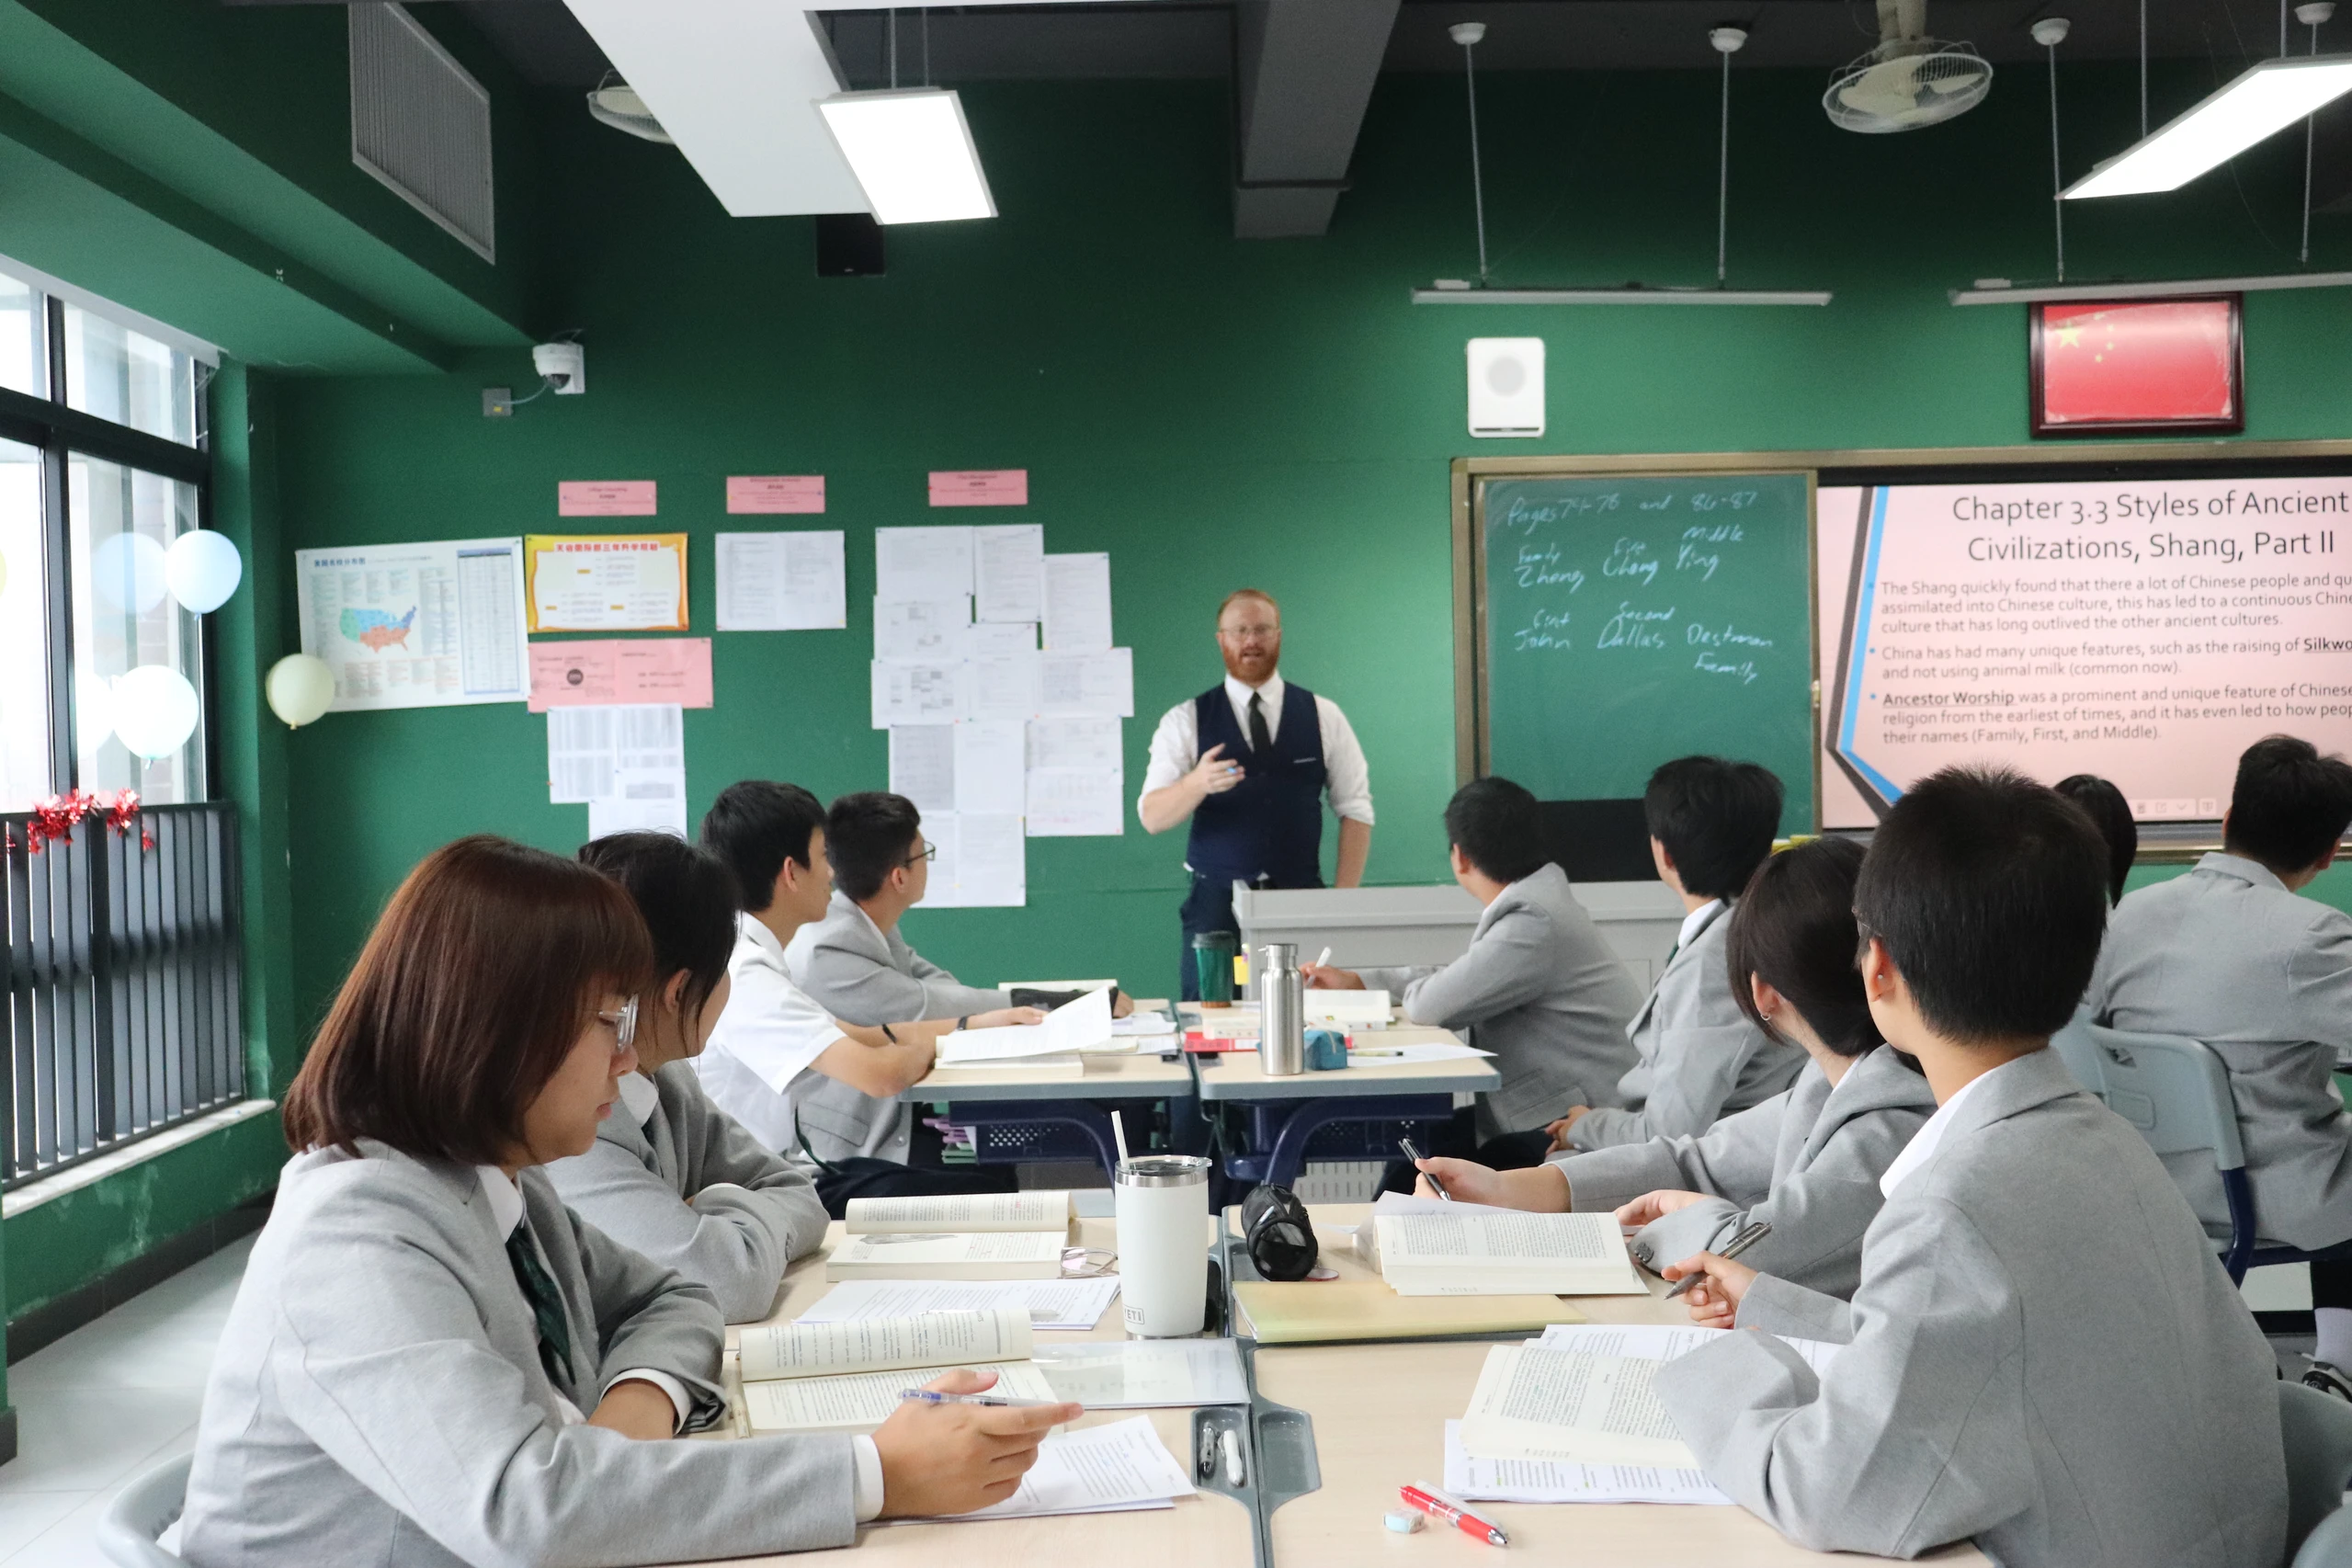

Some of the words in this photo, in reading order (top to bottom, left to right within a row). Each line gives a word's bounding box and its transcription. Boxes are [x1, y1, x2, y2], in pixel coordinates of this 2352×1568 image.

[1953, 495, 2063, 527] Chapter
[2071, 500, 2108, 525] 3.3
[2116, 492, 2199, 524] Styles
[2208, 490, 2236, 516] of
[2242, 490, 2349, 515] Ancient
[1968, 535, 2140, 564] Civilizations,
[2150, 532, 2244, 564] Shang,
[2255, 531, 2312, 555] Part
[2321, 529, 2334, 553] II
[1880, 581, 1908, 595] The
[1911, 581, 1957, 597] Shang
[1960, 579, 2011, 596] quickly
[2015, 578, 2057, 593] found
[2061, 579, 2091, 592] that
[2095, 578, 2132, 591] there
[2136, 579, 2144, 590] a
[2148, 576, 2167, 589] lot
[2171, 574, 2187, 589] of
[2188, 574, 2246, 588] Chinese
[2250, 574, 2299, 590] people
[2303, 573, 2330, 586] and
[2334, 575, 2352, 589] qu
[1880, 599, 1963, 614] assimilated
[1966, 600, 1994, 612] into
[1997, 598, 2054, 612] Chinese
[2058, 597, 2113, 612] culture,
[2117, 596, 2143, 609] this
[2146, 595, 2171, 608] has
[2175, 595, 2197, 608] led
[2200, 596, 2216, 608] to
[2220, 597, 2228, 608] a
[2232, 594, 2312, 607] continuous
[1880, 619, 1931, 633] culture
[1935, 619, 1964, 632] that
[1968, 618, 1994, 631] has
[1996, 618, 2028, 634] long
[2031, 616, 2090, 631] outlived
[2094, 616, 2118, 629] the
[2121, 615, 2161, 629] other
[2164, 614, 2218, 628] ancient
[2221, 613, 2283, 627] cultures.
[1881, 646, 1923, 660] China
[1926, 646, 1951, 659] has
[1955, 644, 1982, 658] had
[1985, 646, 2026, 660] many
[2029, 643, 2078, 660] unique
[2082, 642, 2146, 657] features,
[2149, 641, 2182, 654] such
[2186, 642, 2202, 653] as
[2205, 640, 2229, 653] the
[2233, 639, 2280, 655] raising
[2284, 636, 2301, 652] of
[2303, 636, 2352, 653] Silkwo
[1882, 665, 1909, 679] and
[1913, 666, 1937, 679] not
[1940, 665, 1979, 681] using
[1983, 663, 2030, 677] animal
[2035, 662, 2064, 676] milk
[2069, 662, 2139, 677] (common
[2142, 660, 2182, 676] now).
[1883, 692, 1949, 707] Ancestor
[1952, 690, 2015, 707] Worship
[2018, 692, 2046, 703] was
[2050, 691, 2058, 702] a
[2062, 689, 2137, 704] prominent
[2141, 687, 2168, 700] and
[2172, 686, 2221, 702] unique
[2224, 684, 2277, 699] feature
[2280, 682, 2296, 698] of
[1883, 711, 1937, 728] religion
[1940, 710, 1975, 724] from
[1979, 709, 2003, 722] the
[2006, 708, 2060, 722] earliest
[2063, 706, 2079, 722] of
[2082, 708, 2126, 722] times,
[2130, 706, 2157, 720] and
[2161, 706, 2170, 720] it
[2174, 705, 2199, 719] has
[2202, 706, 2237, 718] even
[2241, 703, 2263, 717] led
[2267, 705, 2282, 717] to
[2285, 703, 2317, 716] how
[1883, 730, 1917, 744] their
[1921, 731, 1969, 744] names
[1971, 728, 2028, 744] (Family,
[2033, 726, 2068, 743] First,
[2073, 726, 2099, 740] and
[2104, 724, 2162, 741] Middle).
